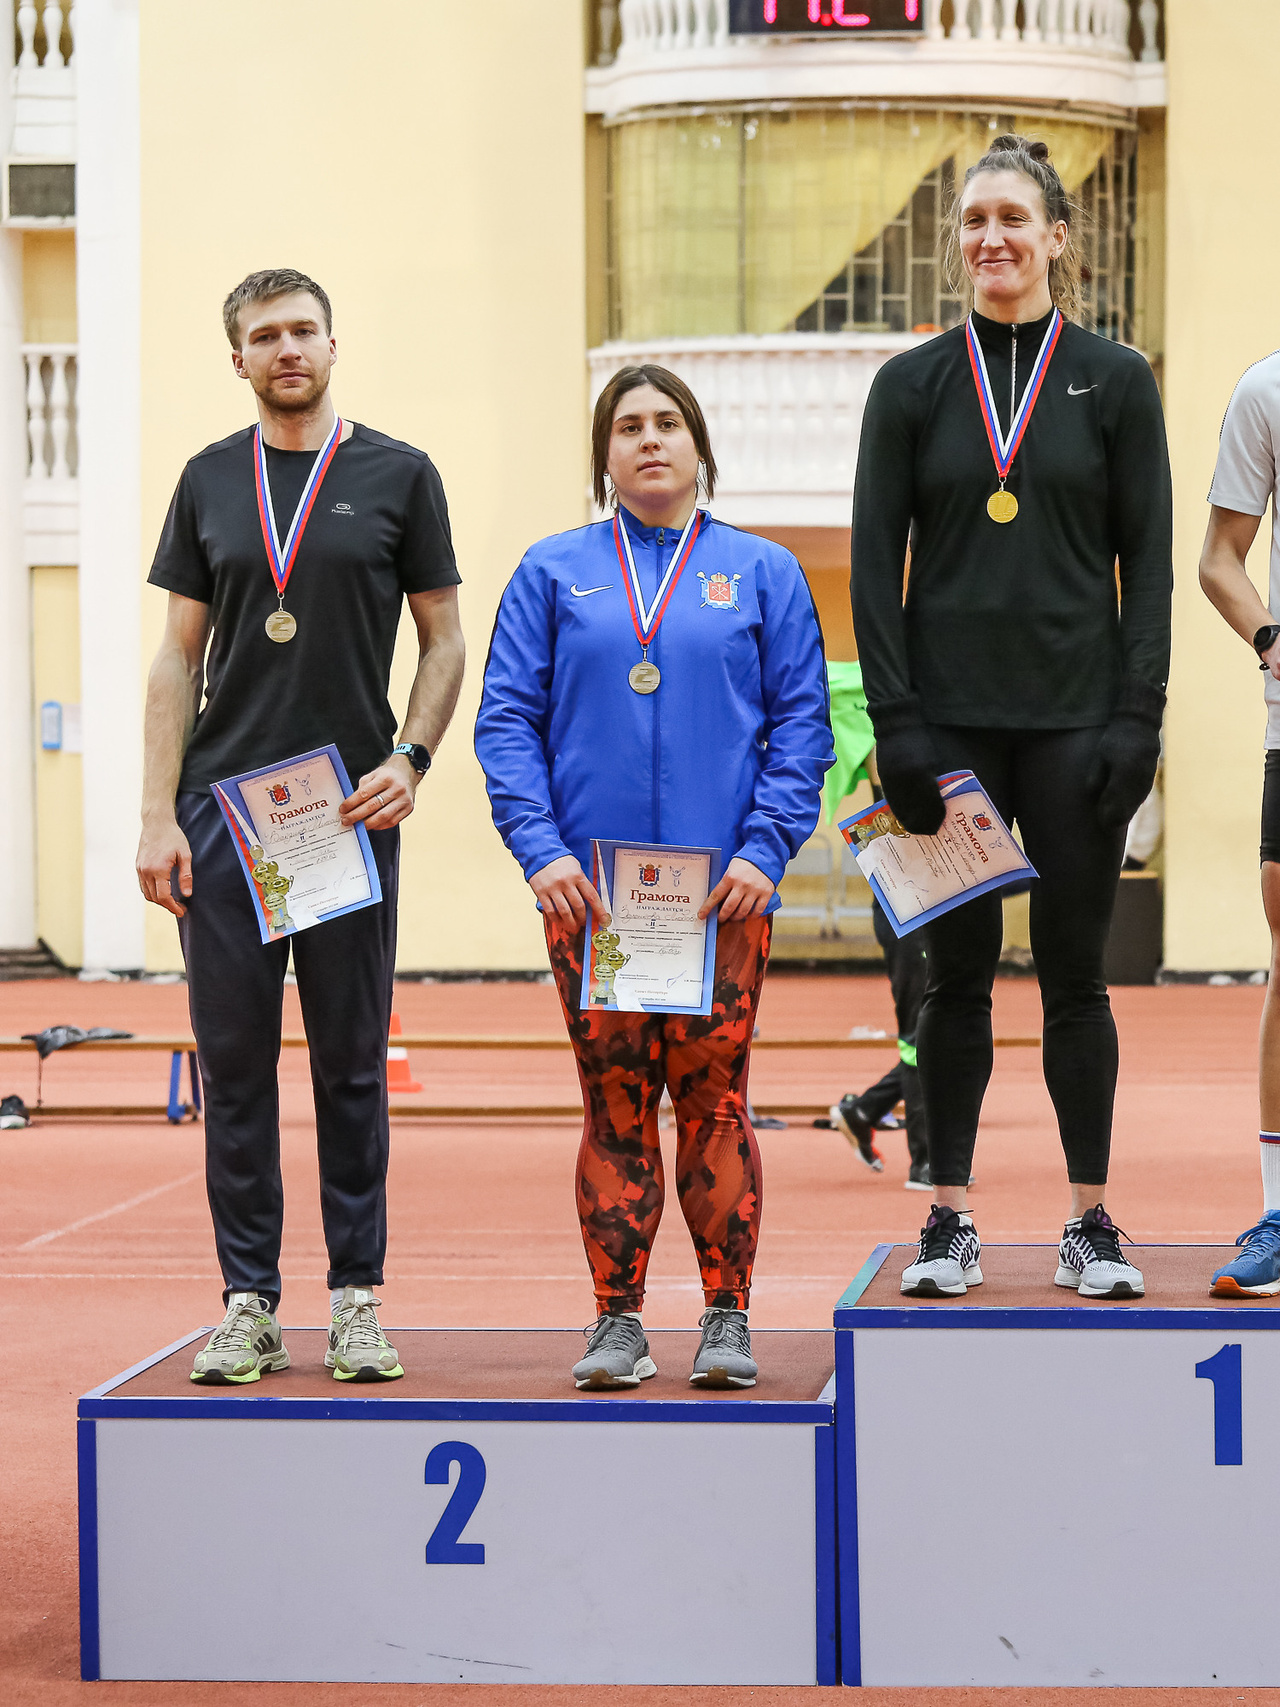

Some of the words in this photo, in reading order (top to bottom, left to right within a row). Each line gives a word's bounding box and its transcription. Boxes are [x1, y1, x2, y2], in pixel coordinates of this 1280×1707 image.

[269, 798, 329, 825] Грамота
[955, 811, 989, 864] Грамота
[630, 889, 690, 904] Грамота
[1195, 1344, 1243, 1465] 1
[425, 1441, 486, 1564] 2
